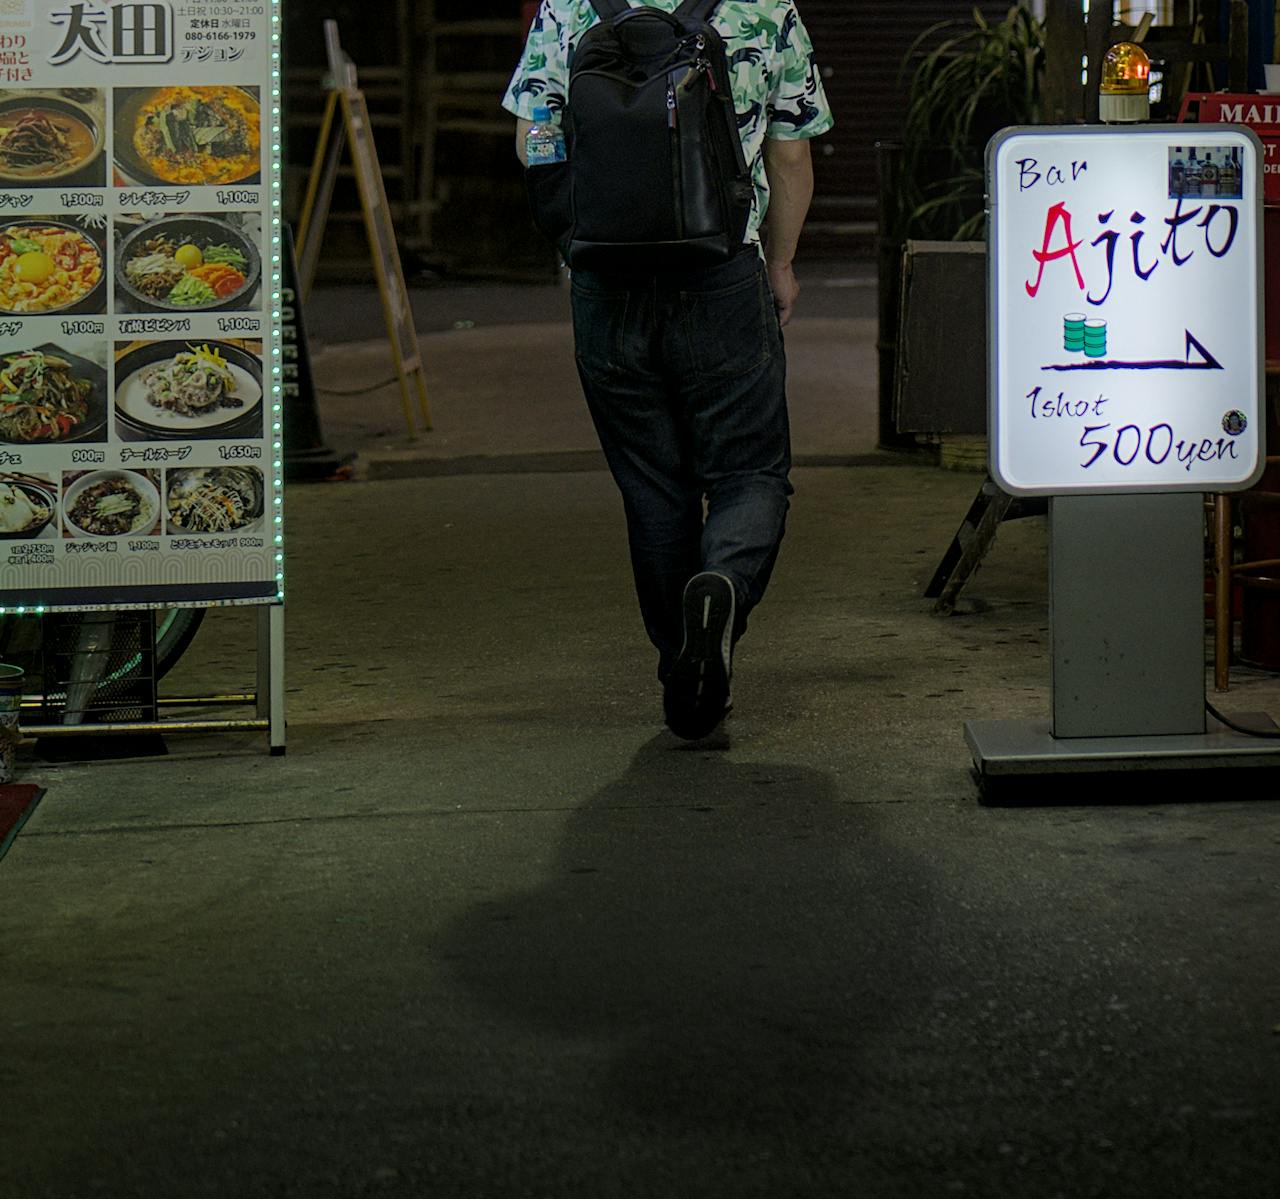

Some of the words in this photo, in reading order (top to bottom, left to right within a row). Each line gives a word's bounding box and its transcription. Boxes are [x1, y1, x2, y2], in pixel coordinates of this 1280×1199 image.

[50, 2, 169, 59] 大田
[1018, 156, 1089, 192] Bar
[61, 193, 104, 207] 1,300円
[216, 190, 260, 205] 1,100円
[1024, 196, 1239, 306] Ajito
[61, 321, 104, 336] 1,100円
[217, 317, 260, 332] 1,100円
[1024, 385, 1109, 421] 1shot
[72, 449, 105, 463] 900円
[120, 445, 193, 462] テールスープ
[1079, 422, 1241, 481] 500yen
[239, 537, 264, 548] 900円
